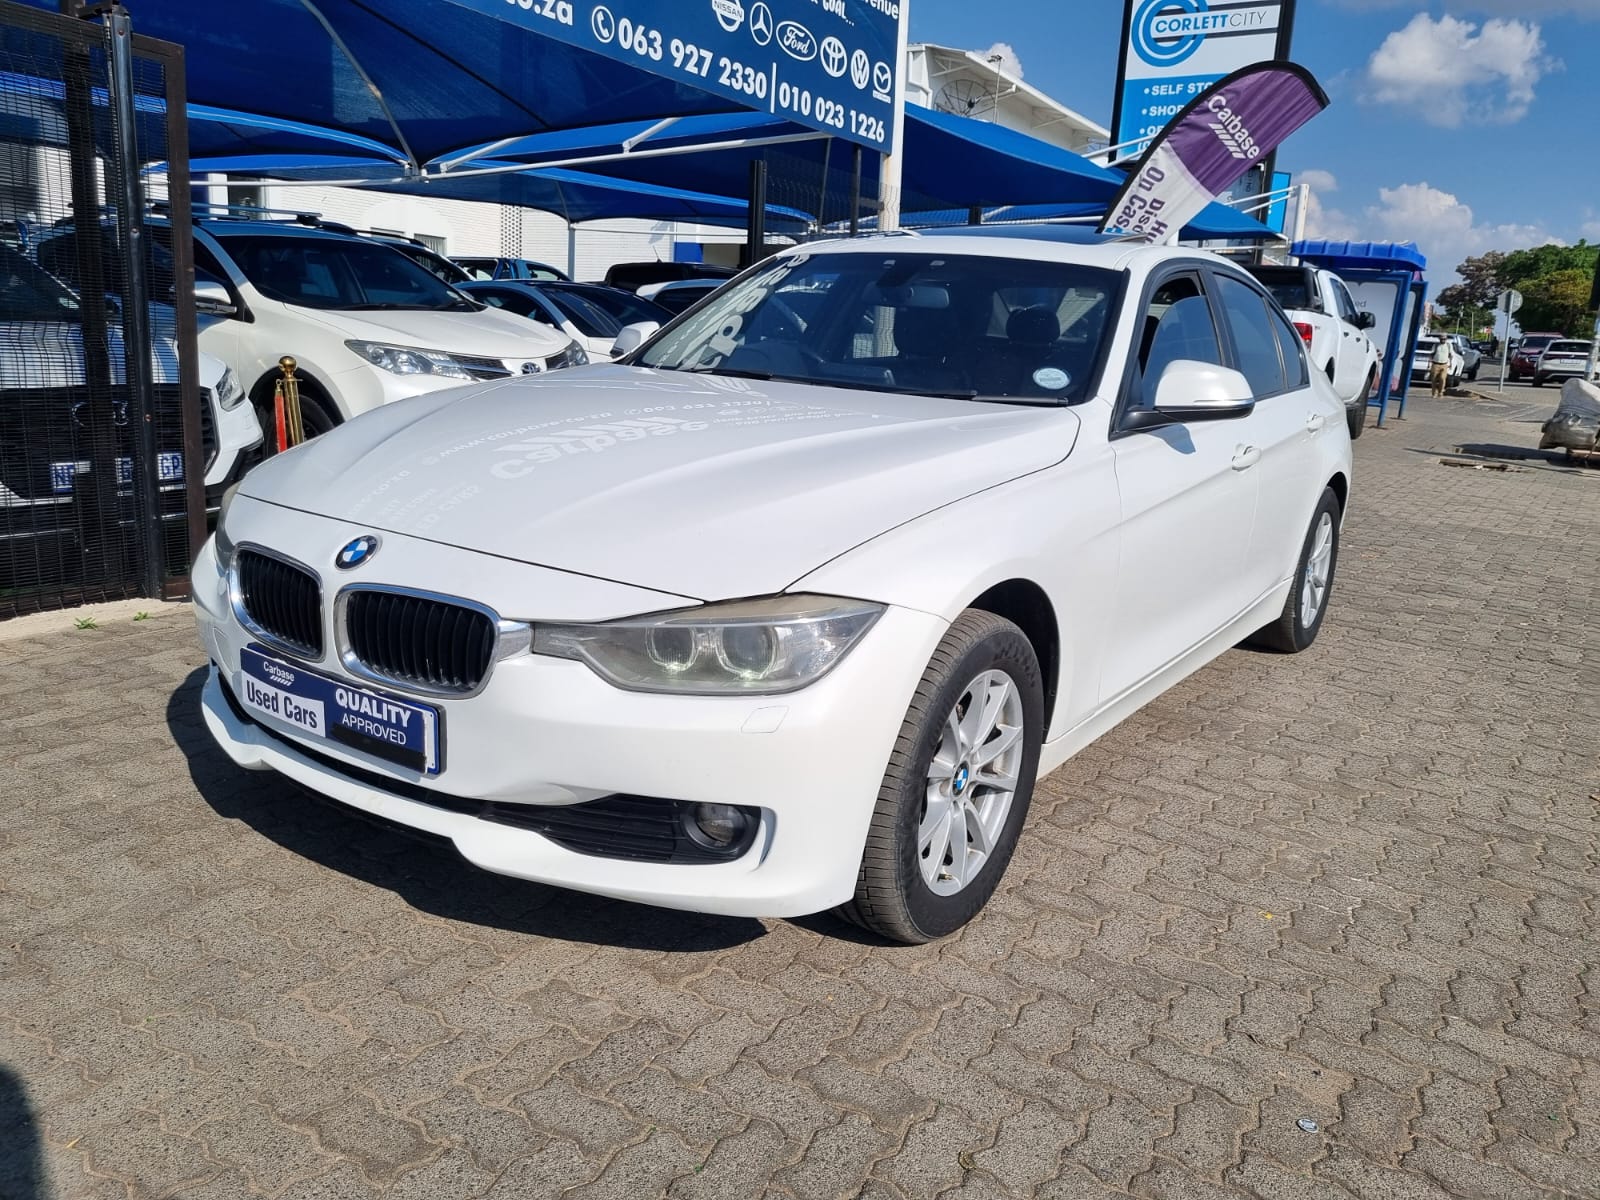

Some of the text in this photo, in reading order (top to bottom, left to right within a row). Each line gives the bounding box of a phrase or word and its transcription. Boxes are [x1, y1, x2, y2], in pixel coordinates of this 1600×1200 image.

[713, 0, 743, 18] NISSAN
[783, 26, 811, 54] Ford
[618, 18, 885, 143] 063 927 2330 010 023 1226
[1151, 84, 1184, 96] SELF
[1208, 95, 1260, 159] Carbase
[1138, 166, 1165, 192] On
[263, 661, 295, 682] Carbase
[246, 679, 317, 729] Used Cars
[335, 688, 411, 728] QUALITY
[342, 713, 407, 745] APPROVED
